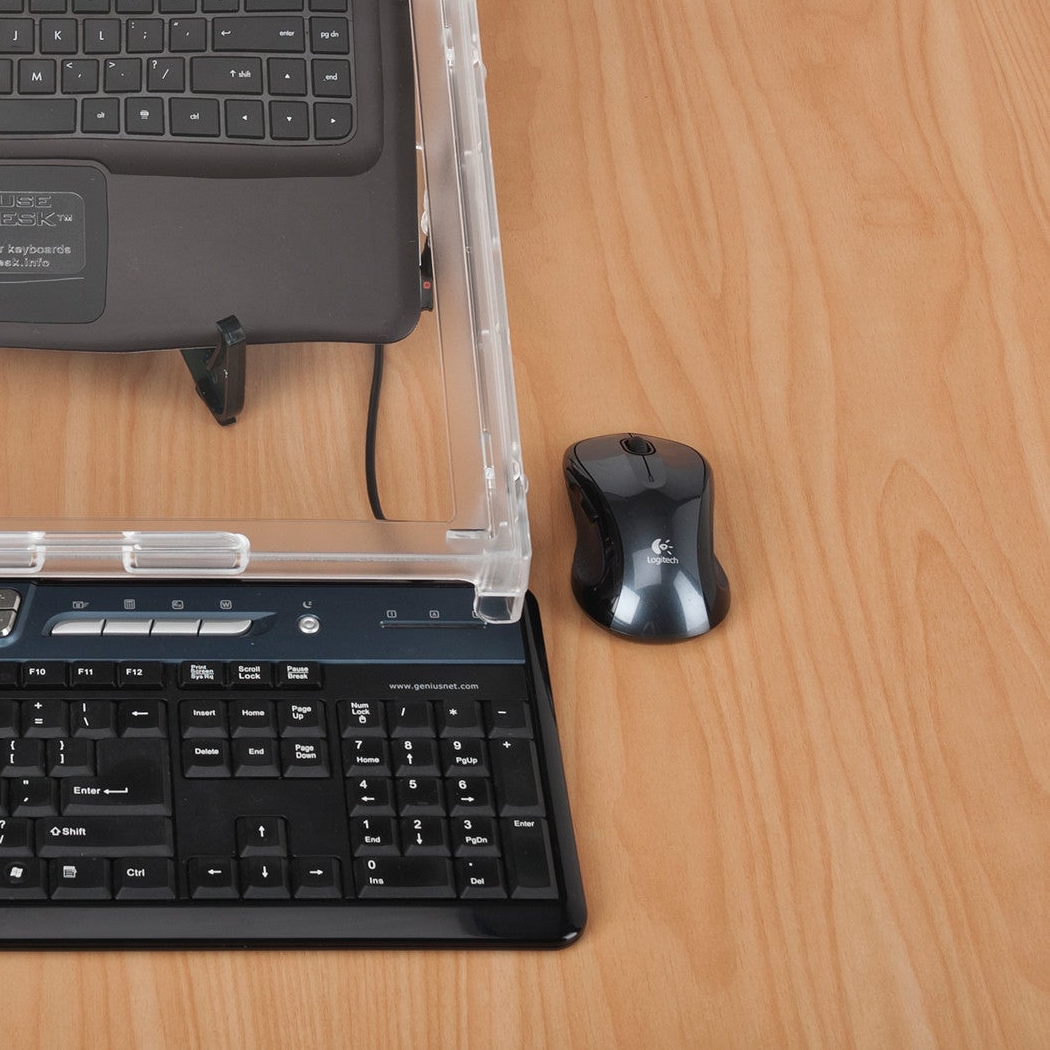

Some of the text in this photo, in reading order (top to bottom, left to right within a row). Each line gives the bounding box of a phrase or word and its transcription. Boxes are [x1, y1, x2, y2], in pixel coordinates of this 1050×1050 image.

[8, 244, 71, 255] keyboards
[646, 555, 678, 565] Logitech
[287, 665, 309, 673] Pause
[292, 706, 311, 716] Page
[293, 712, 304, 720] Up
[295, 744, 315, 754] Page
[355, 741, 362, 749] 7
[453, 741, 461, 750] 9
[296, 751, 316, 759] Down
[456, 757, 477, 765] PgUp
[364, 820, 368, 828] 1
[414, 820, 421, 829] 2
[464, 820, 471, 829] 3
